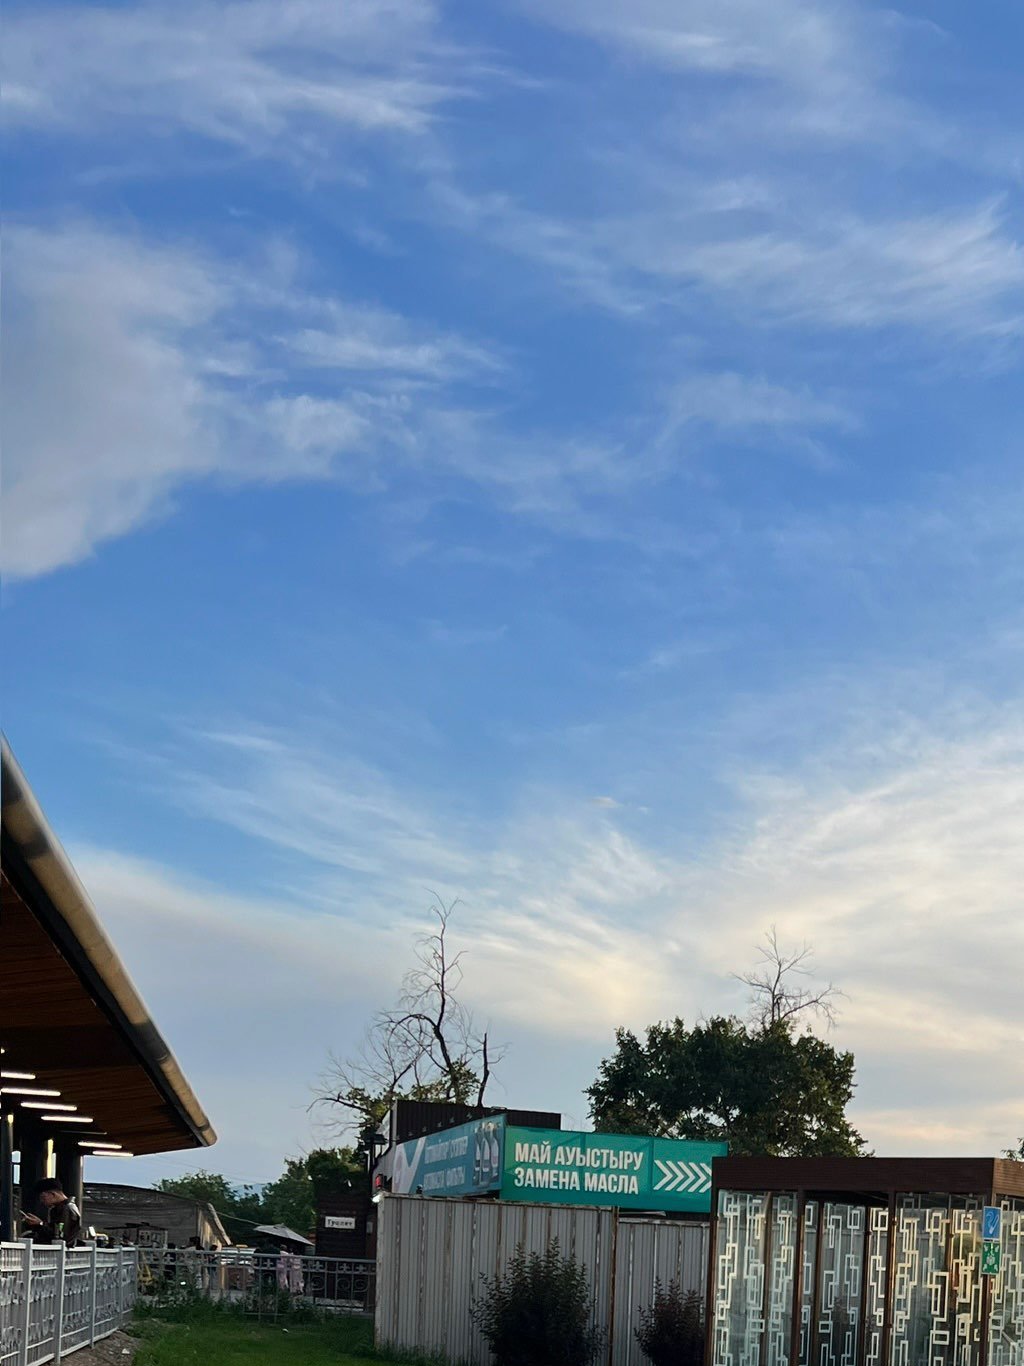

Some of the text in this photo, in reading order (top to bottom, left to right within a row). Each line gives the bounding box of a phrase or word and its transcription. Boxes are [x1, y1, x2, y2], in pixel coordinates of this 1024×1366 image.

[515, 1141, 644, 1171] МАЙ АУЫСТЫРУ
[514, 1167, 639, 1195] ЗАМЕНА МАСЛА
